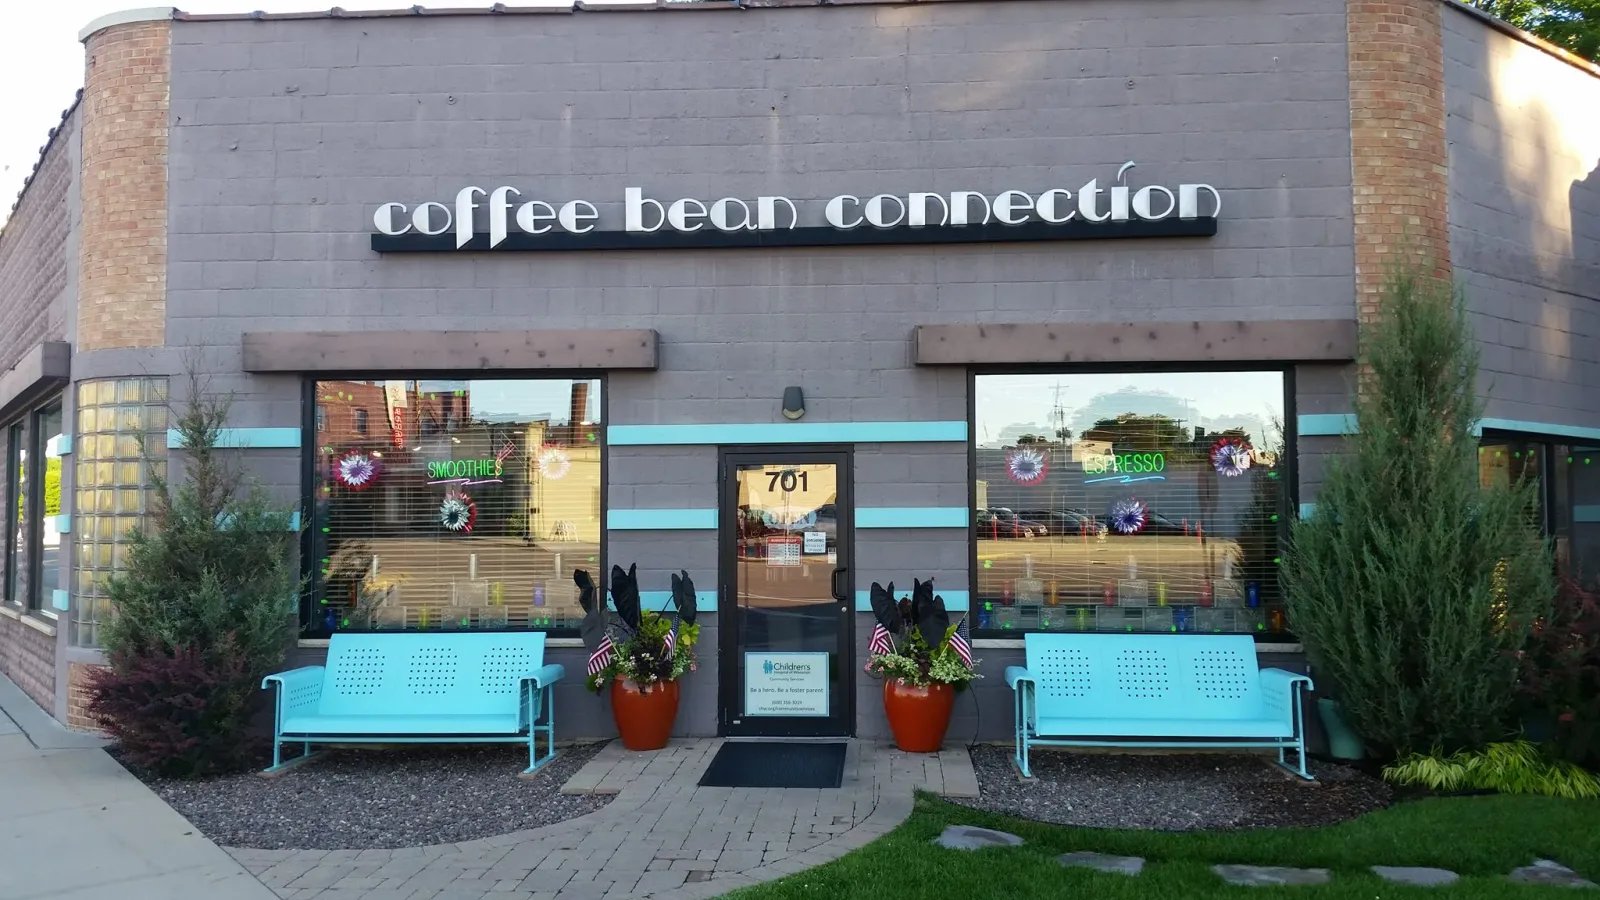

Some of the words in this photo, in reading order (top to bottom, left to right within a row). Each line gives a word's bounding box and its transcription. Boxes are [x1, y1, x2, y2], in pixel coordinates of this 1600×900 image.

[373, 186, 599, 250] coffee
[625, 187, 798, 232] bean
[825, 160, 1222, 229] connection
[427, 459, 503, 479] SMOOTHIES
[1083, 453, 1165, 474] ESPRESSO
[765, 470, 808, 492] 701
